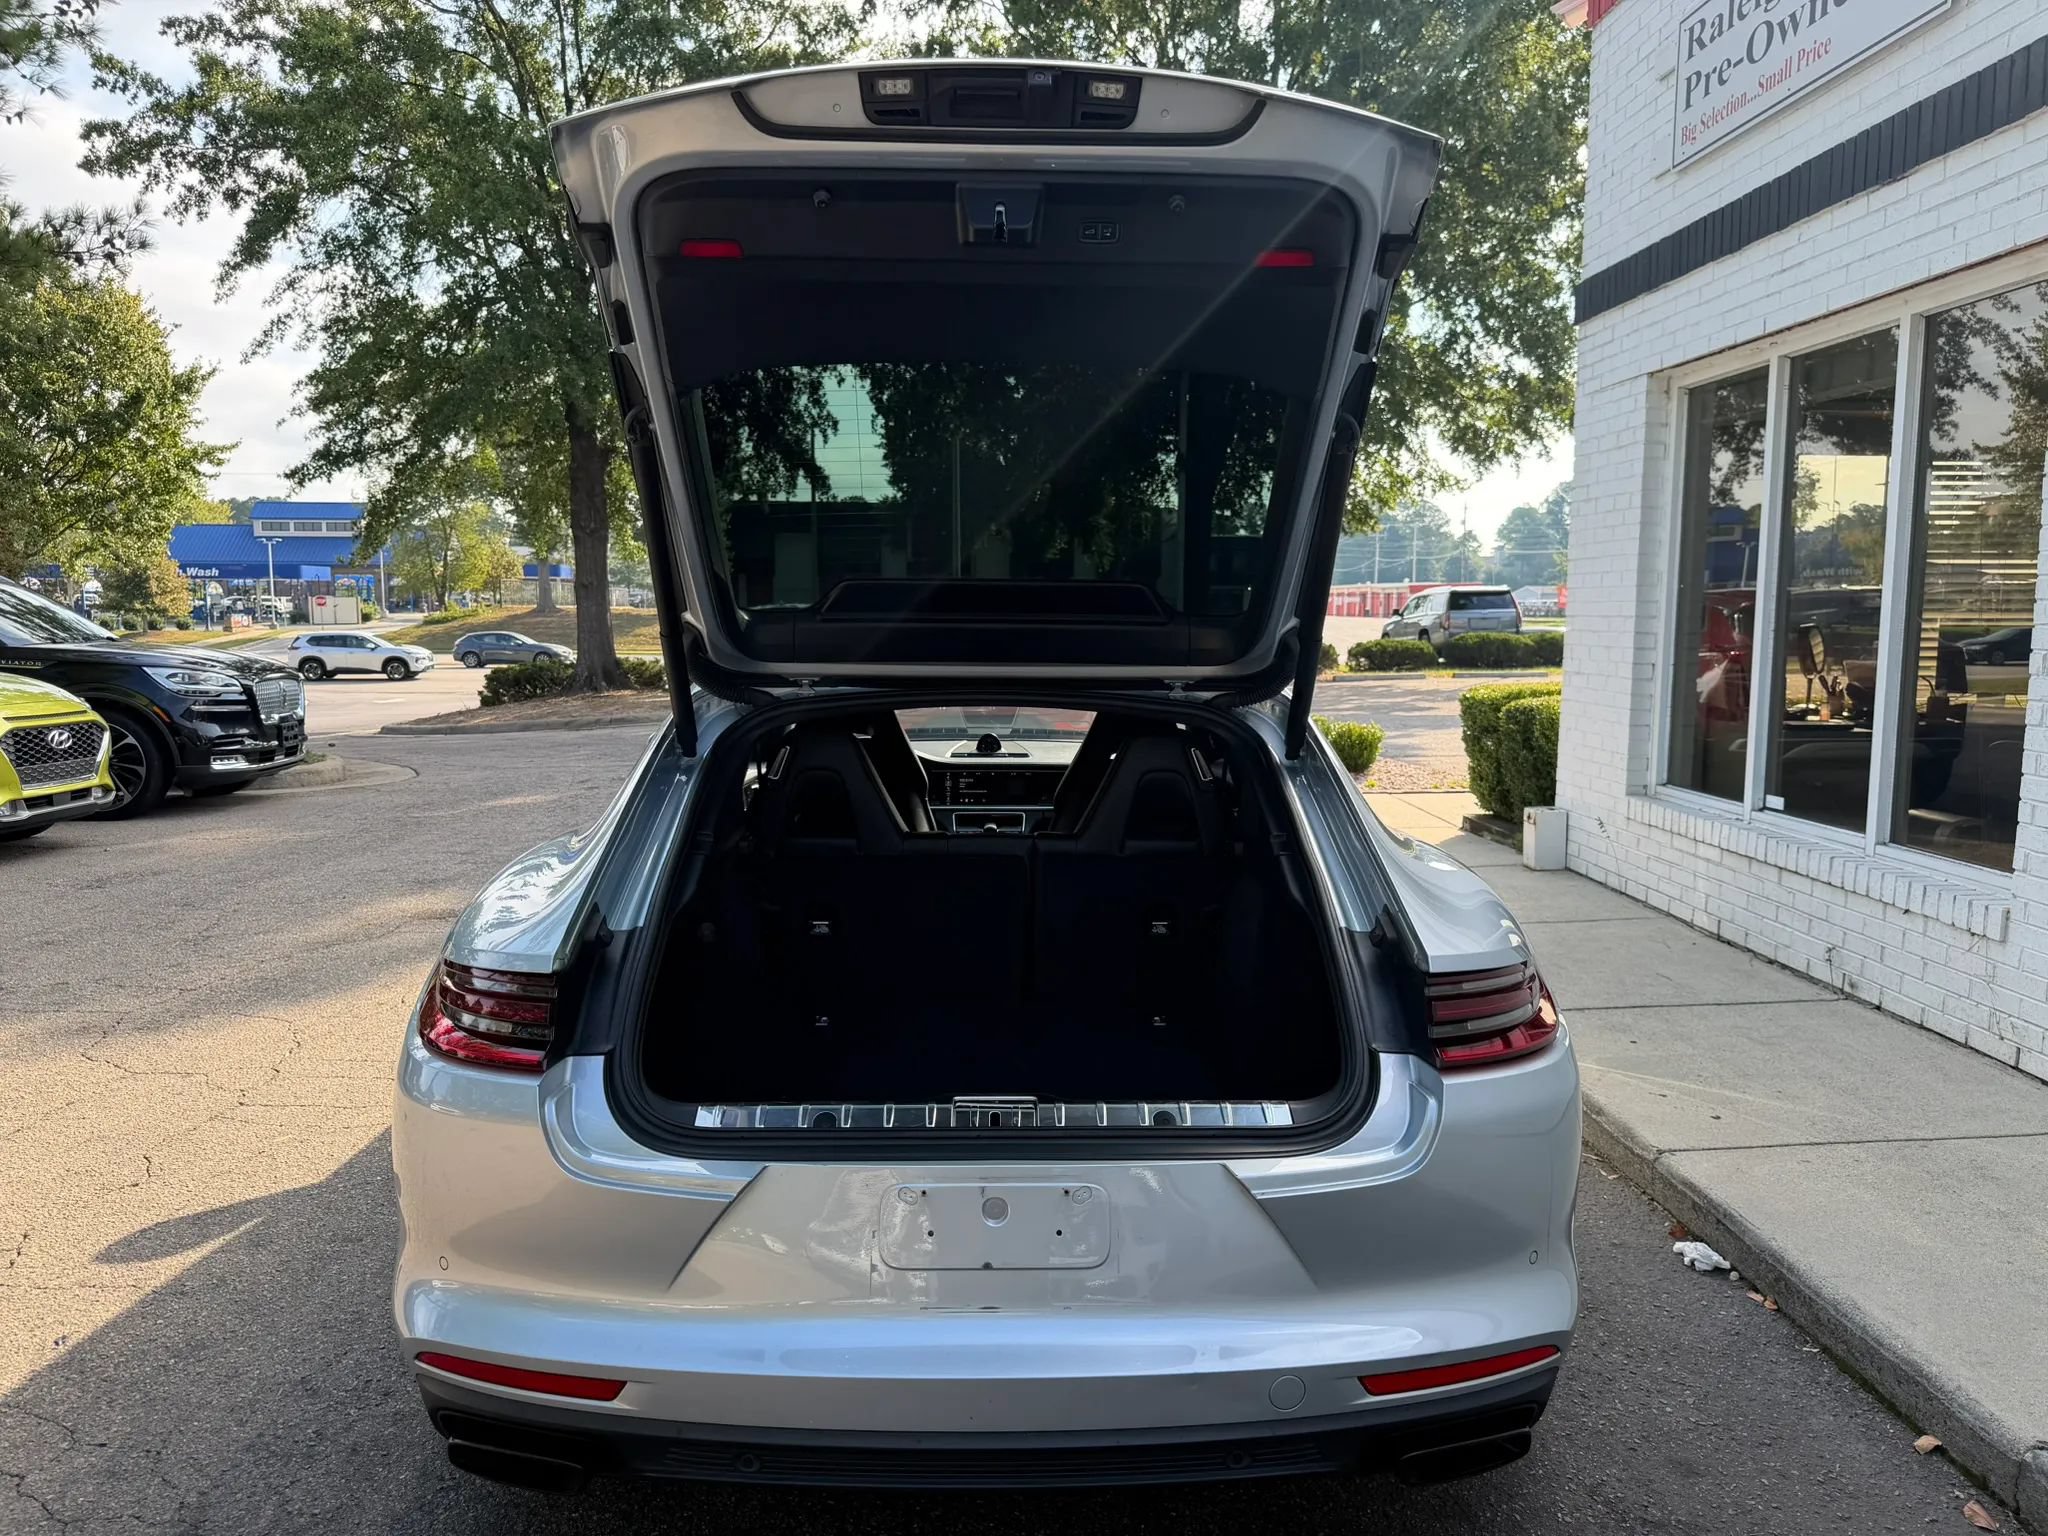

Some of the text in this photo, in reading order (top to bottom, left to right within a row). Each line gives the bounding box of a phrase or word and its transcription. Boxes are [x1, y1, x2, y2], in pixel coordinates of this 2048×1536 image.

[1684, 0, 1784, 64] Rale
[1681, 119, 1697, 146] Big
[1796, 37, 1832, 73] Price
[186, 567, 219, 577] Wash
